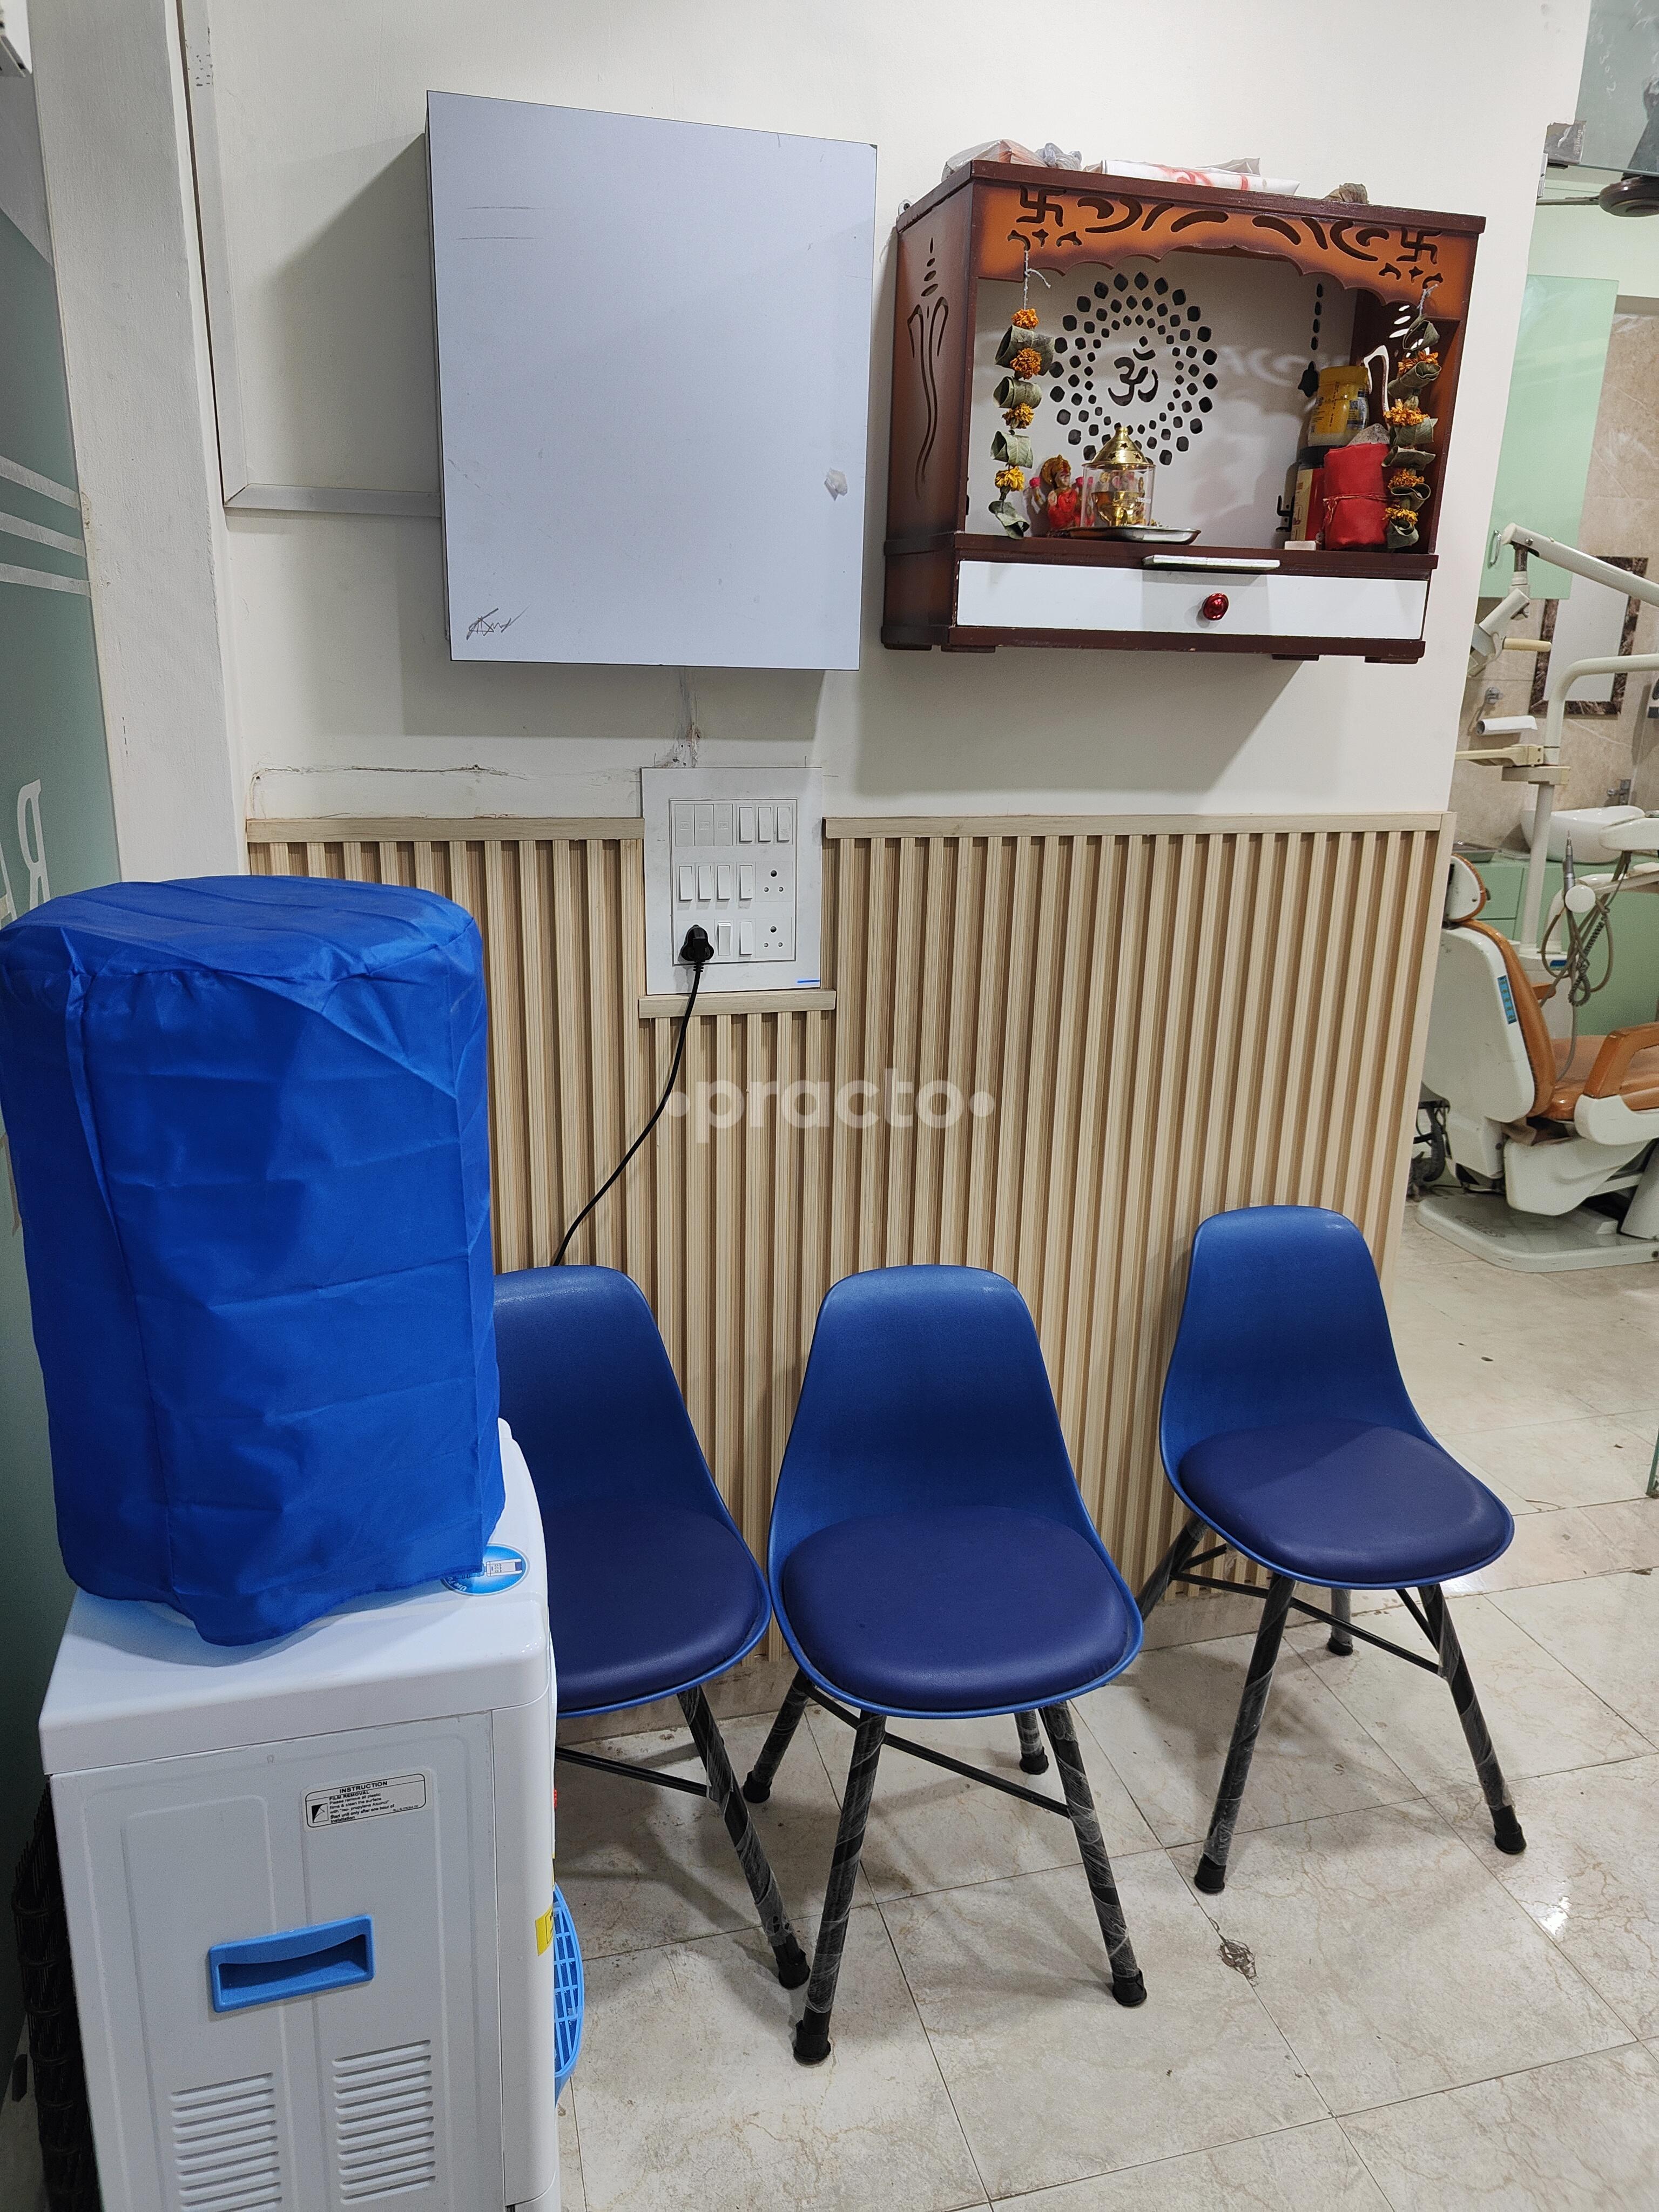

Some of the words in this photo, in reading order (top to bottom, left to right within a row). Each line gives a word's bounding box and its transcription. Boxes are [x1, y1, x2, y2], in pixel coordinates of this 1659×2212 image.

[454, 1582, 467, 1591] Use
[339, 1781, 388, 1793] INSTRUCTION
[343, 1790, 370, 1798] REMOVAL
